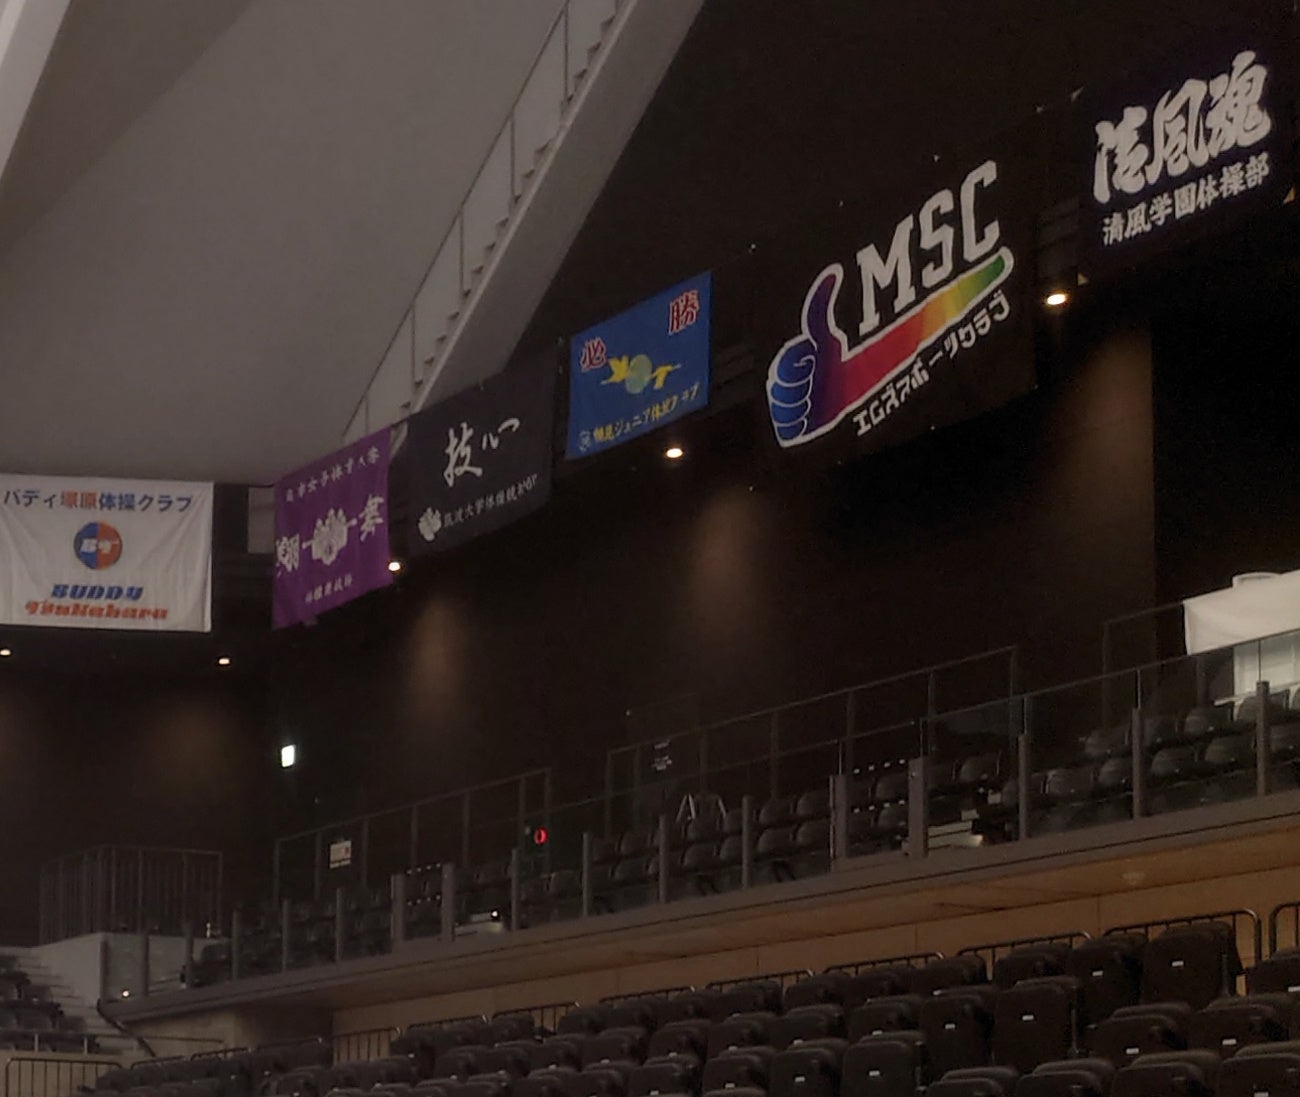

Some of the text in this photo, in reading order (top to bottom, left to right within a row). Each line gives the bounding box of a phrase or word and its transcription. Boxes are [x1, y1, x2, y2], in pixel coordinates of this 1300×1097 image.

[856, 160, 1000, 337] MSC
[1103, 152, 1270, 246] 清風学園体操部
[852, 290, 1011, 437] エムズスポーツクラブ
[51, 584, 143, 601] BUDDY
